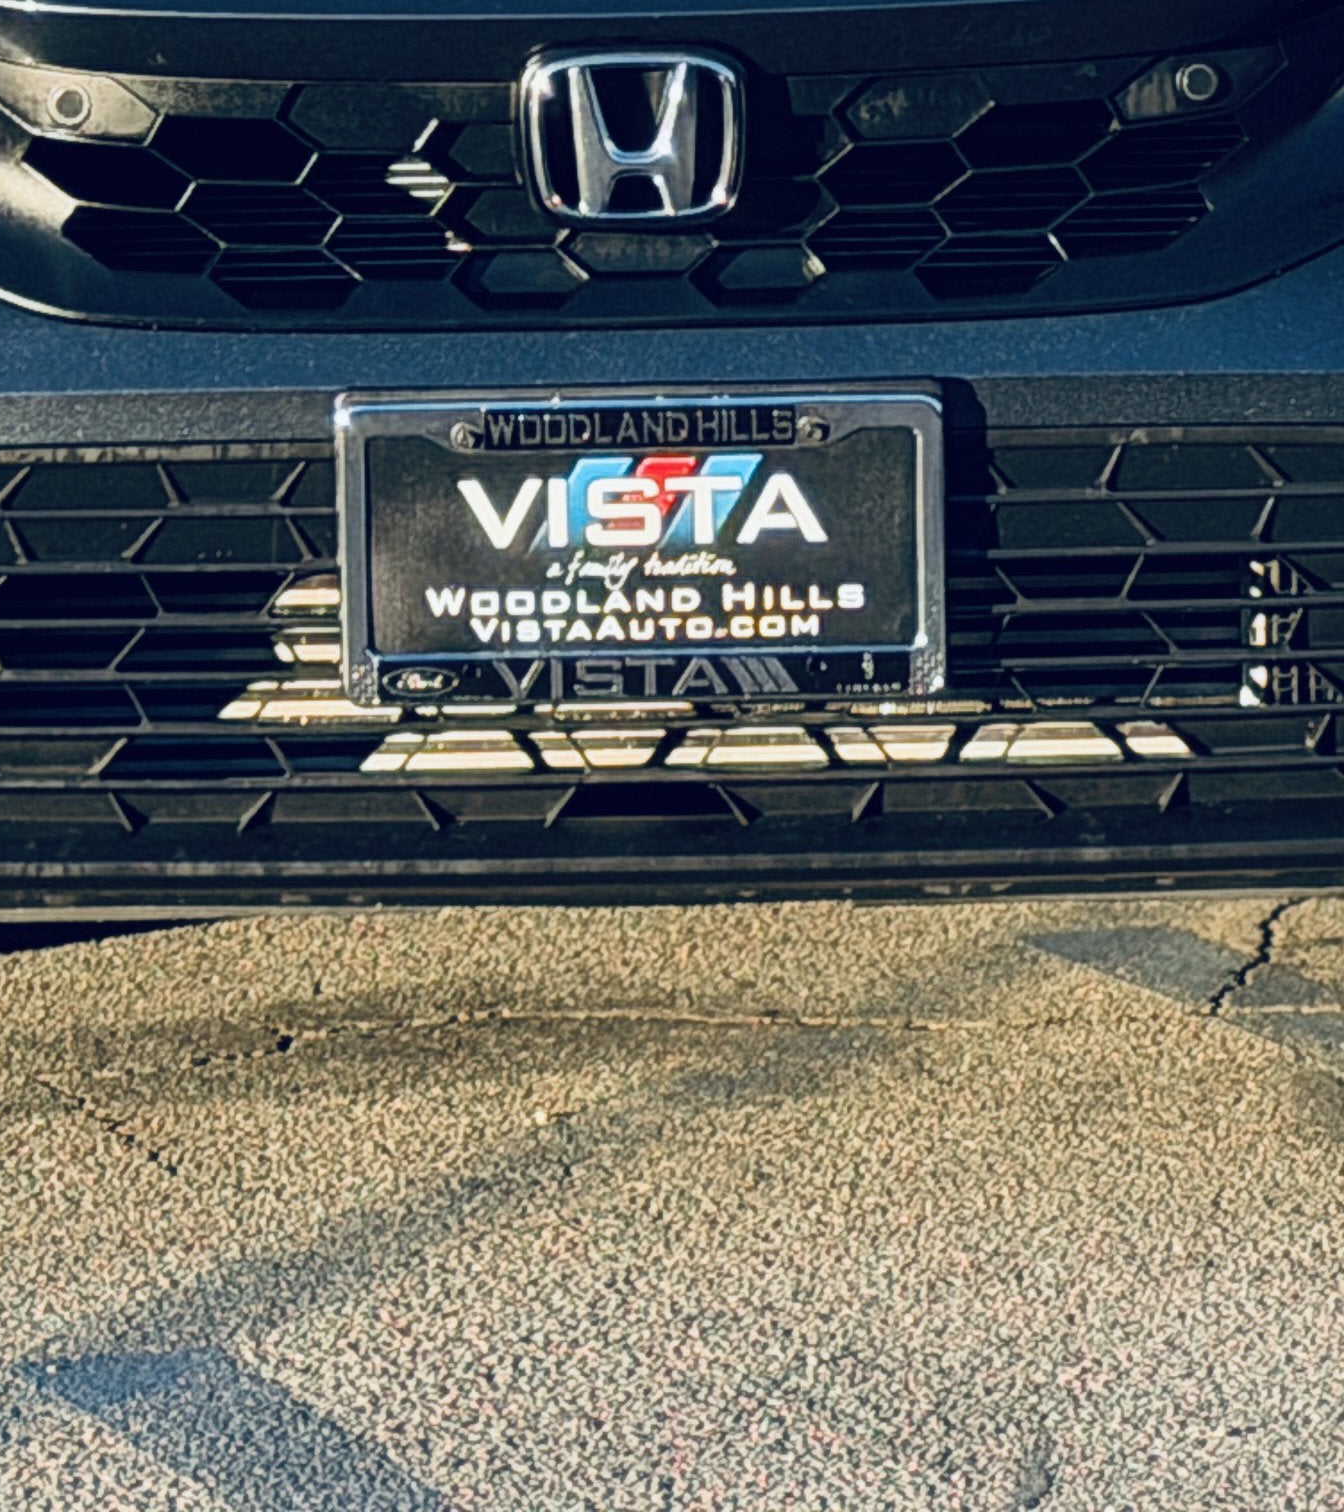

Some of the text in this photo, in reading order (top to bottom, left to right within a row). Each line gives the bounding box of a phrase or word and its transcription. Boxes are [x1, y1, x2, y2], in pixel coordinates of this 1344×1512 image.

[487, 409, 793, 445] WOODLAND HILLS
[457, 472, 829, 550] VISTA
[425, 582, 866, 618] WOODLAND HILLS
[493, 655, 729, 699] VISTA
